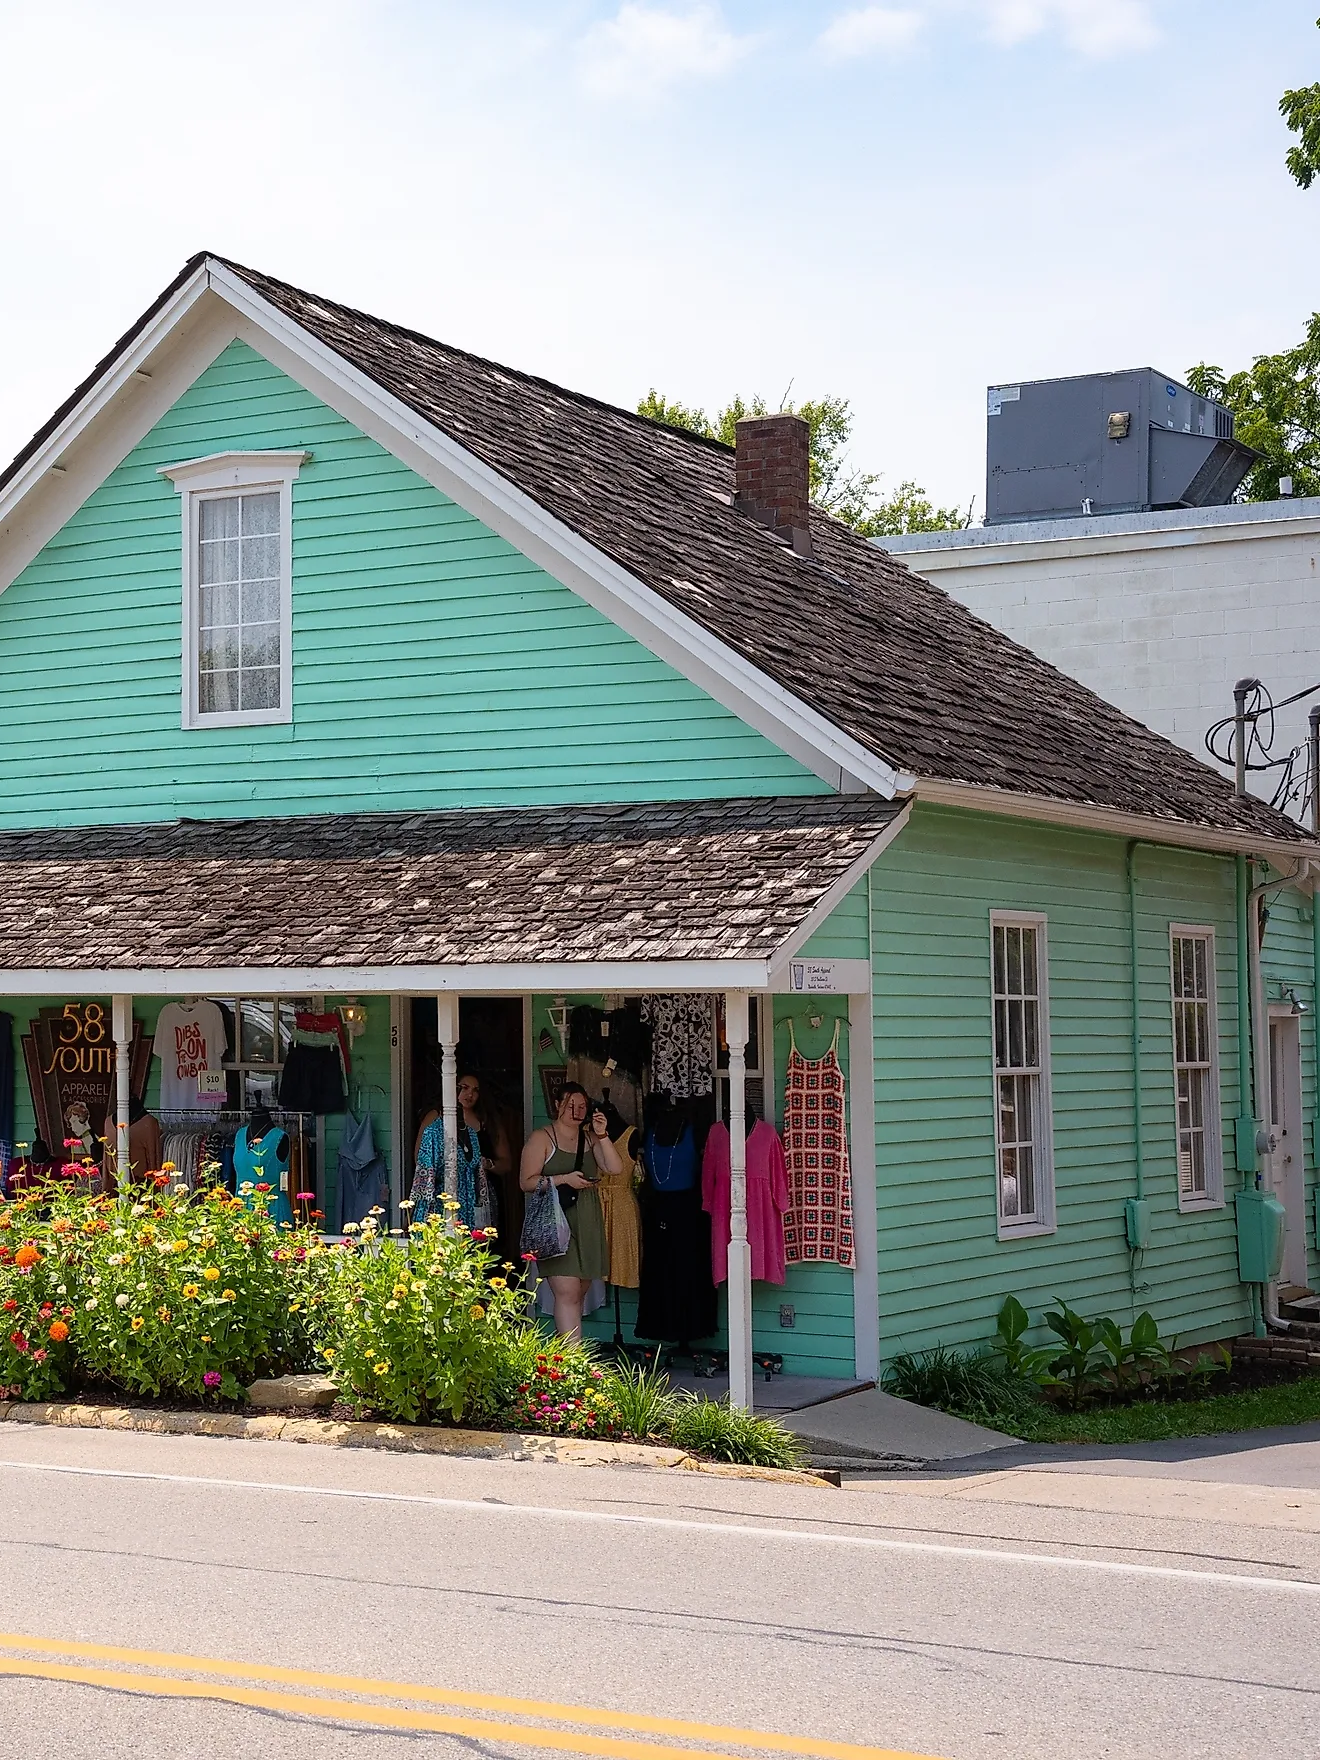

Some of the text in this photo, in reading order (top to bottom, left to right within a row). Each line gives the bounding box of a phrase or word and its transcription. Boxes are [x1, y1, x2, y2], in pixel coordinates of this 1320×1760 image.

[59, 1003, 105, 1043] 58
[175, 1021, 201, 1050] DIBS
[391, 1025, 398, 1047] 58
[187, 1038, 206, 1060] ON
[44, 1047, 119, 1074] SOUTH
[61, 1083, 109, 1096] APPAREL
[206, 1075, 220, 1084] $10
